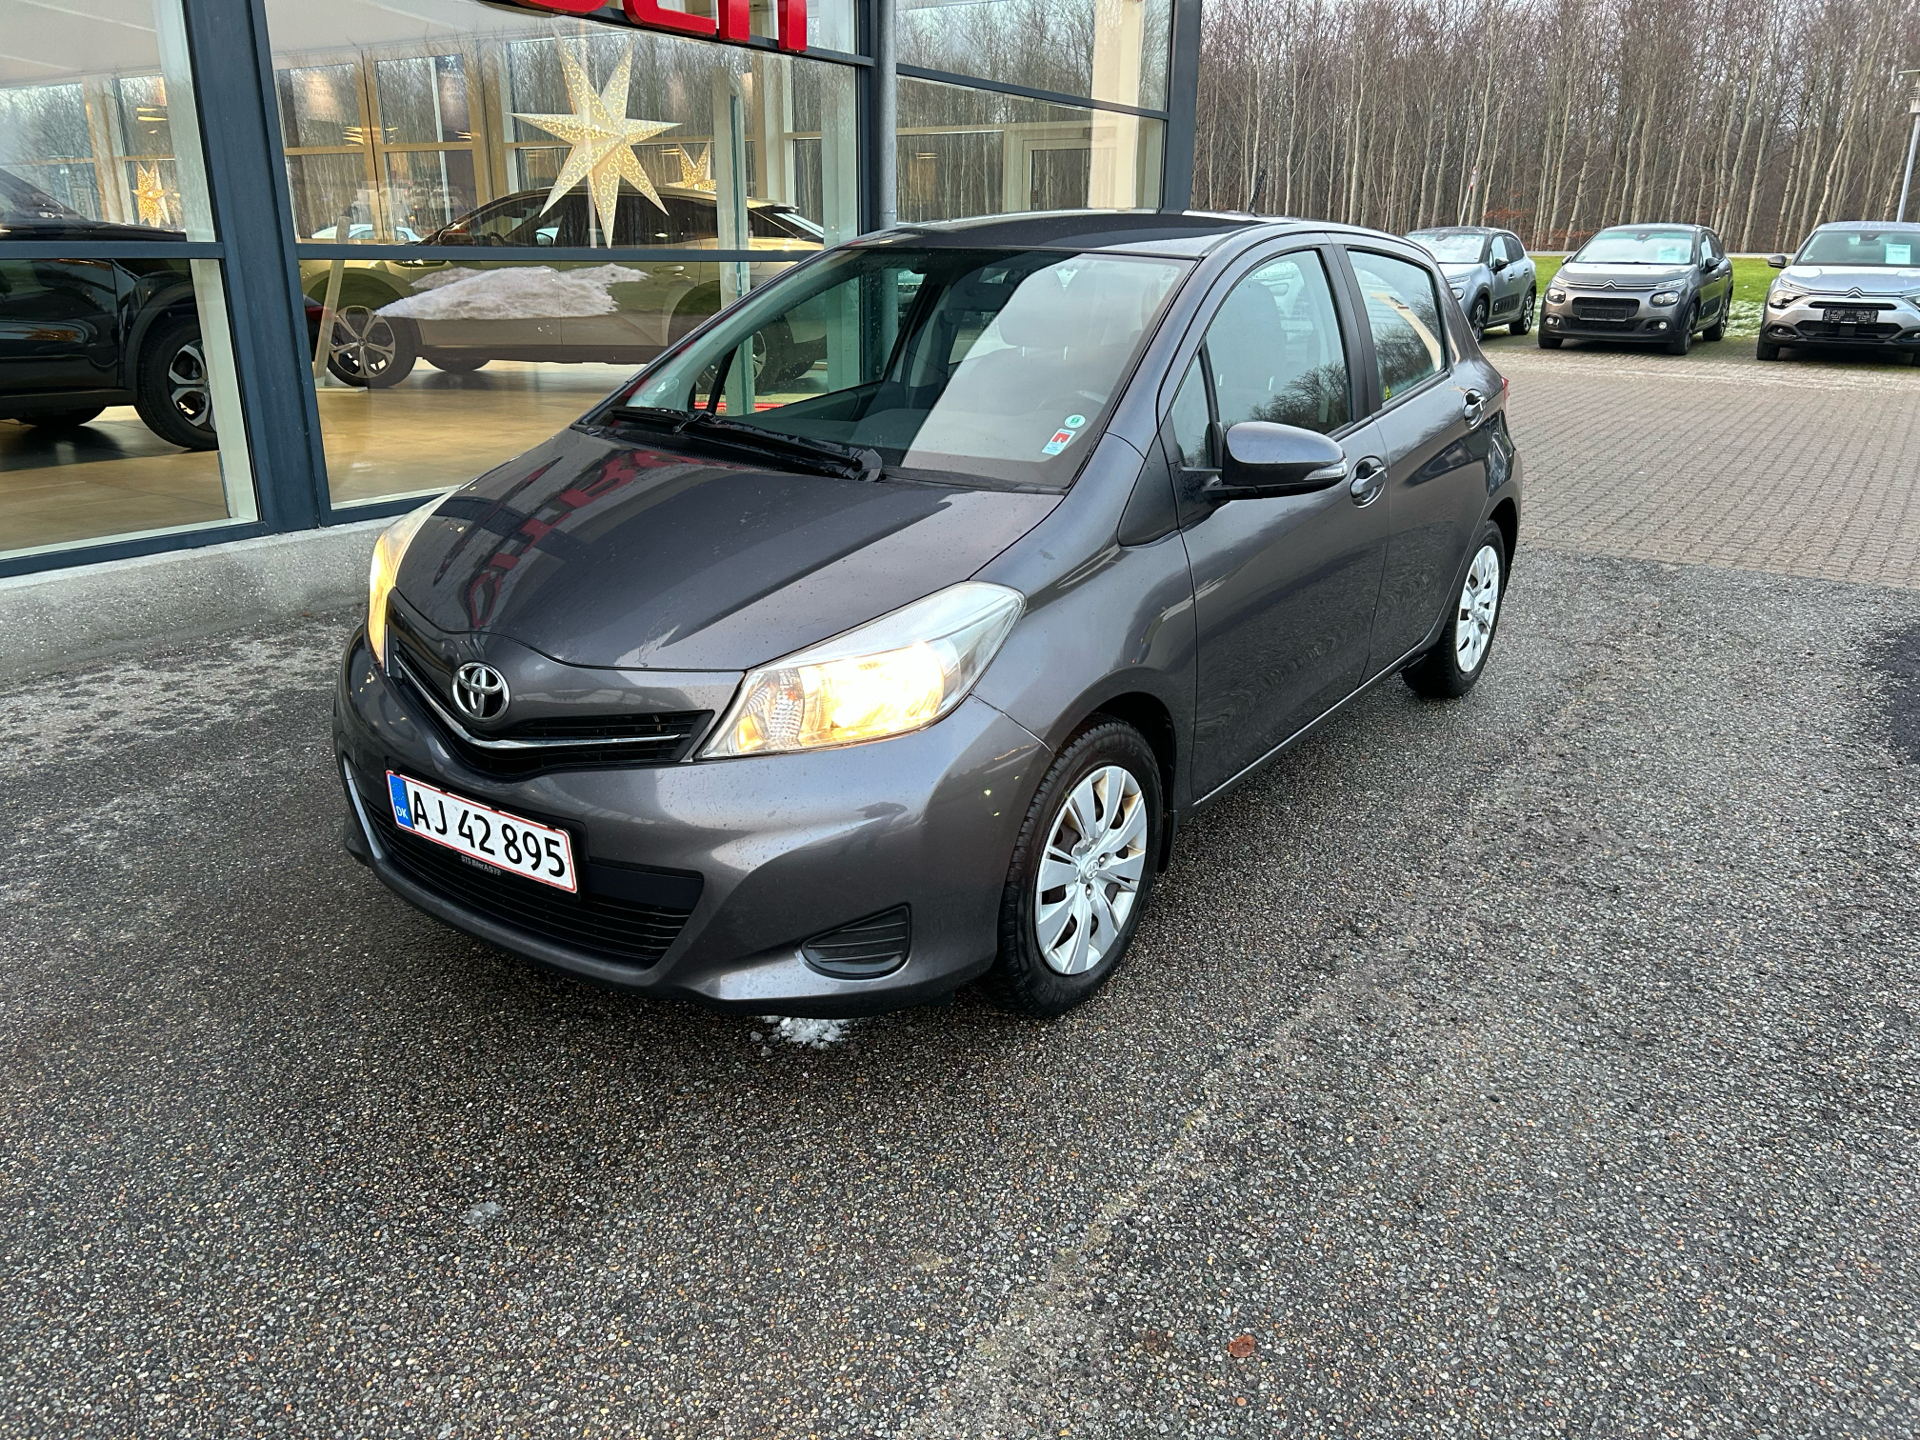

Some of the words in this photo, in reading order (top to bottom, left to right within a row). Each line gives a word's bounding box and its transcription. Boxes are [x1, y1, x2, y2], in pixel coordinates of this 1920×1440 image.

[396, 805, 409, 820] DK
[413, 791, 448, 836] AJ
[458, 809, 496, 857] 42
[501, 823, 566, 877] 895
